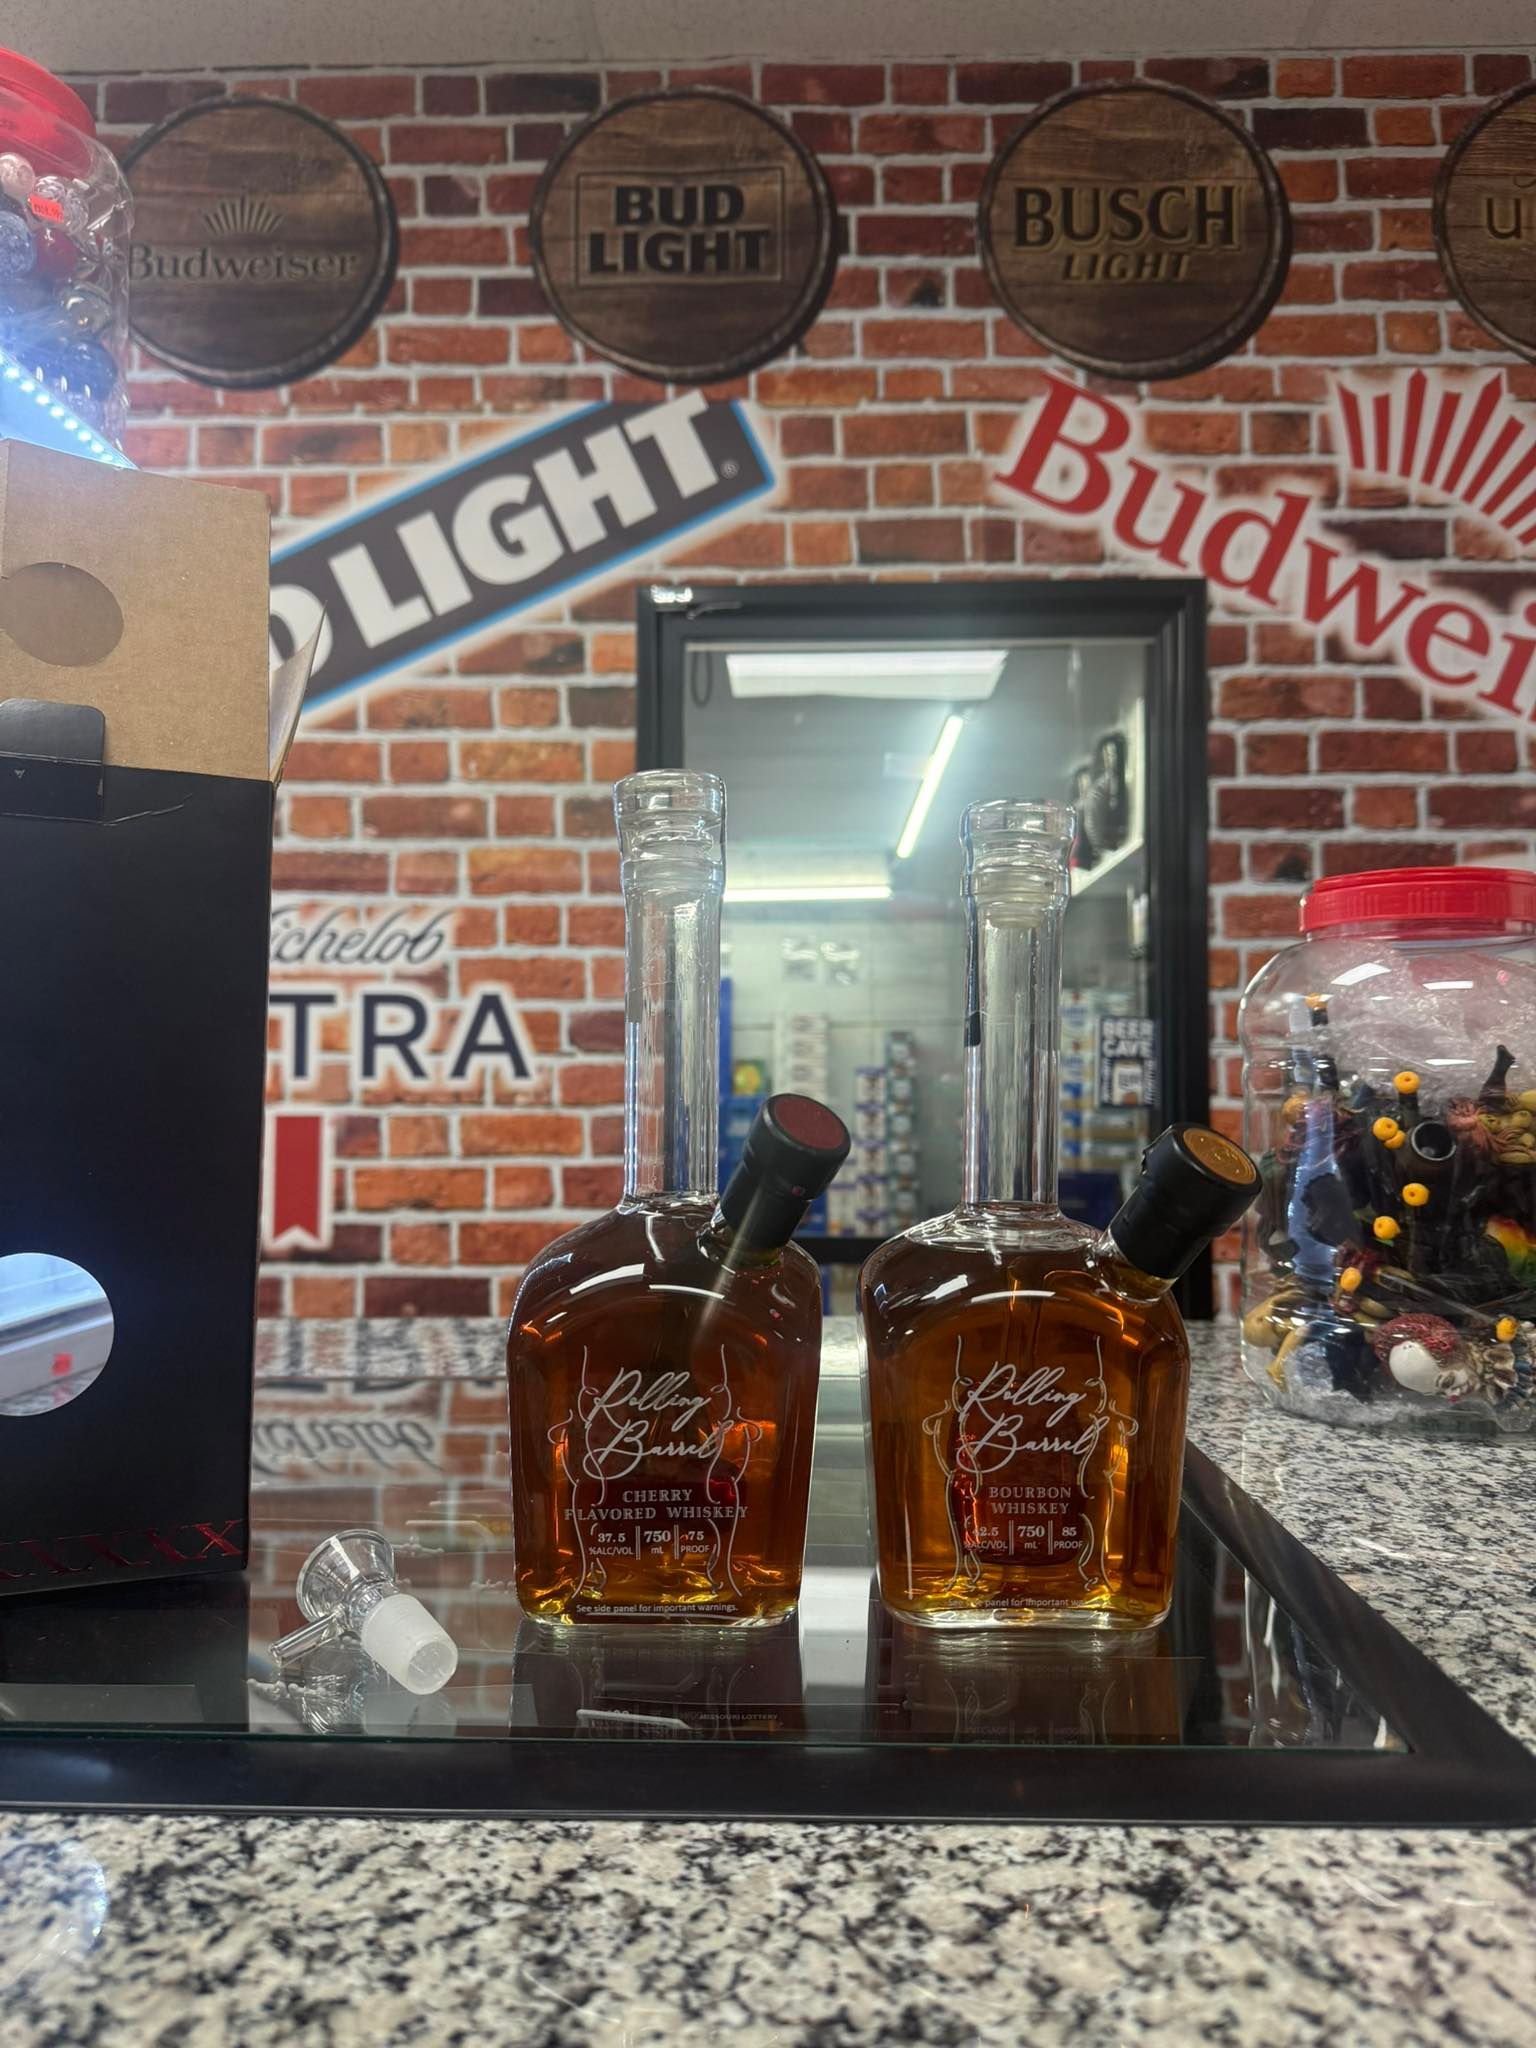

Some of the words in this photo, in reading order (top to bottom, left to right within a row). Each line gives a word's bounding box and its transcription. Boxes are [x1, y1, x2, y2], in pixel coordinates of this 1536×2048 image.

[615, 185, 744, 227] BUD
[1014, 185, 1236, 248] BUSCH
[128, 243, 358, 281] Budweiser
[589, 229, 770, 273] LIGHT
[1061, 252, 1190, 281] LIGHT
[993, 374, 1536, 725] Budwei
[271, 903, 457, 965] ichelob
[268, 993, 532, 1080] TRA
[1102, 1020, 1154, 1039] BEER
[1102, 1040, 1153, 1058] CAVE
[585, 1366, 713, 1432] Rolling
[958, 1360, 1088, 1427] Rolling
[583, 1418, 735, 1480] Barrel
[956, 1412, 1110, 1473] Barrel
[622, 1488, 693, 1503] CHERRY
[989, 1486, 1072, 1499] BOURBON
[564, 1506, 657, 1521] FLAVORED
[666, 1505, 748, 1519] WHISKEY
[991, 1502, 1070, 1515] WHISKEY
[597, 1532, 626, 1543] 37.5
[643, 1530, 671, 1543] 750
[687, 1531, 705, 1541] 75
[1018, 1525, 1046, 1538] 750
[1061, 1526, 1078, 1537] 85
[680, 1544, 711, 1554] PROOF
[1053, 1540, 1084, 1550] PROOF
[576, 1604, 592, 1613] See
[594, 1603, 611, 1613] side
[613, 1604, 638, 1615] panel
[639, 1603, 652, 1613] for
[653, 1603, 696, 1615] important
[698, 1602, 738, 1614] warnings.
[985, 1599, 1009, 1608] panel
[1025, 1598, 1069, 1608] important
